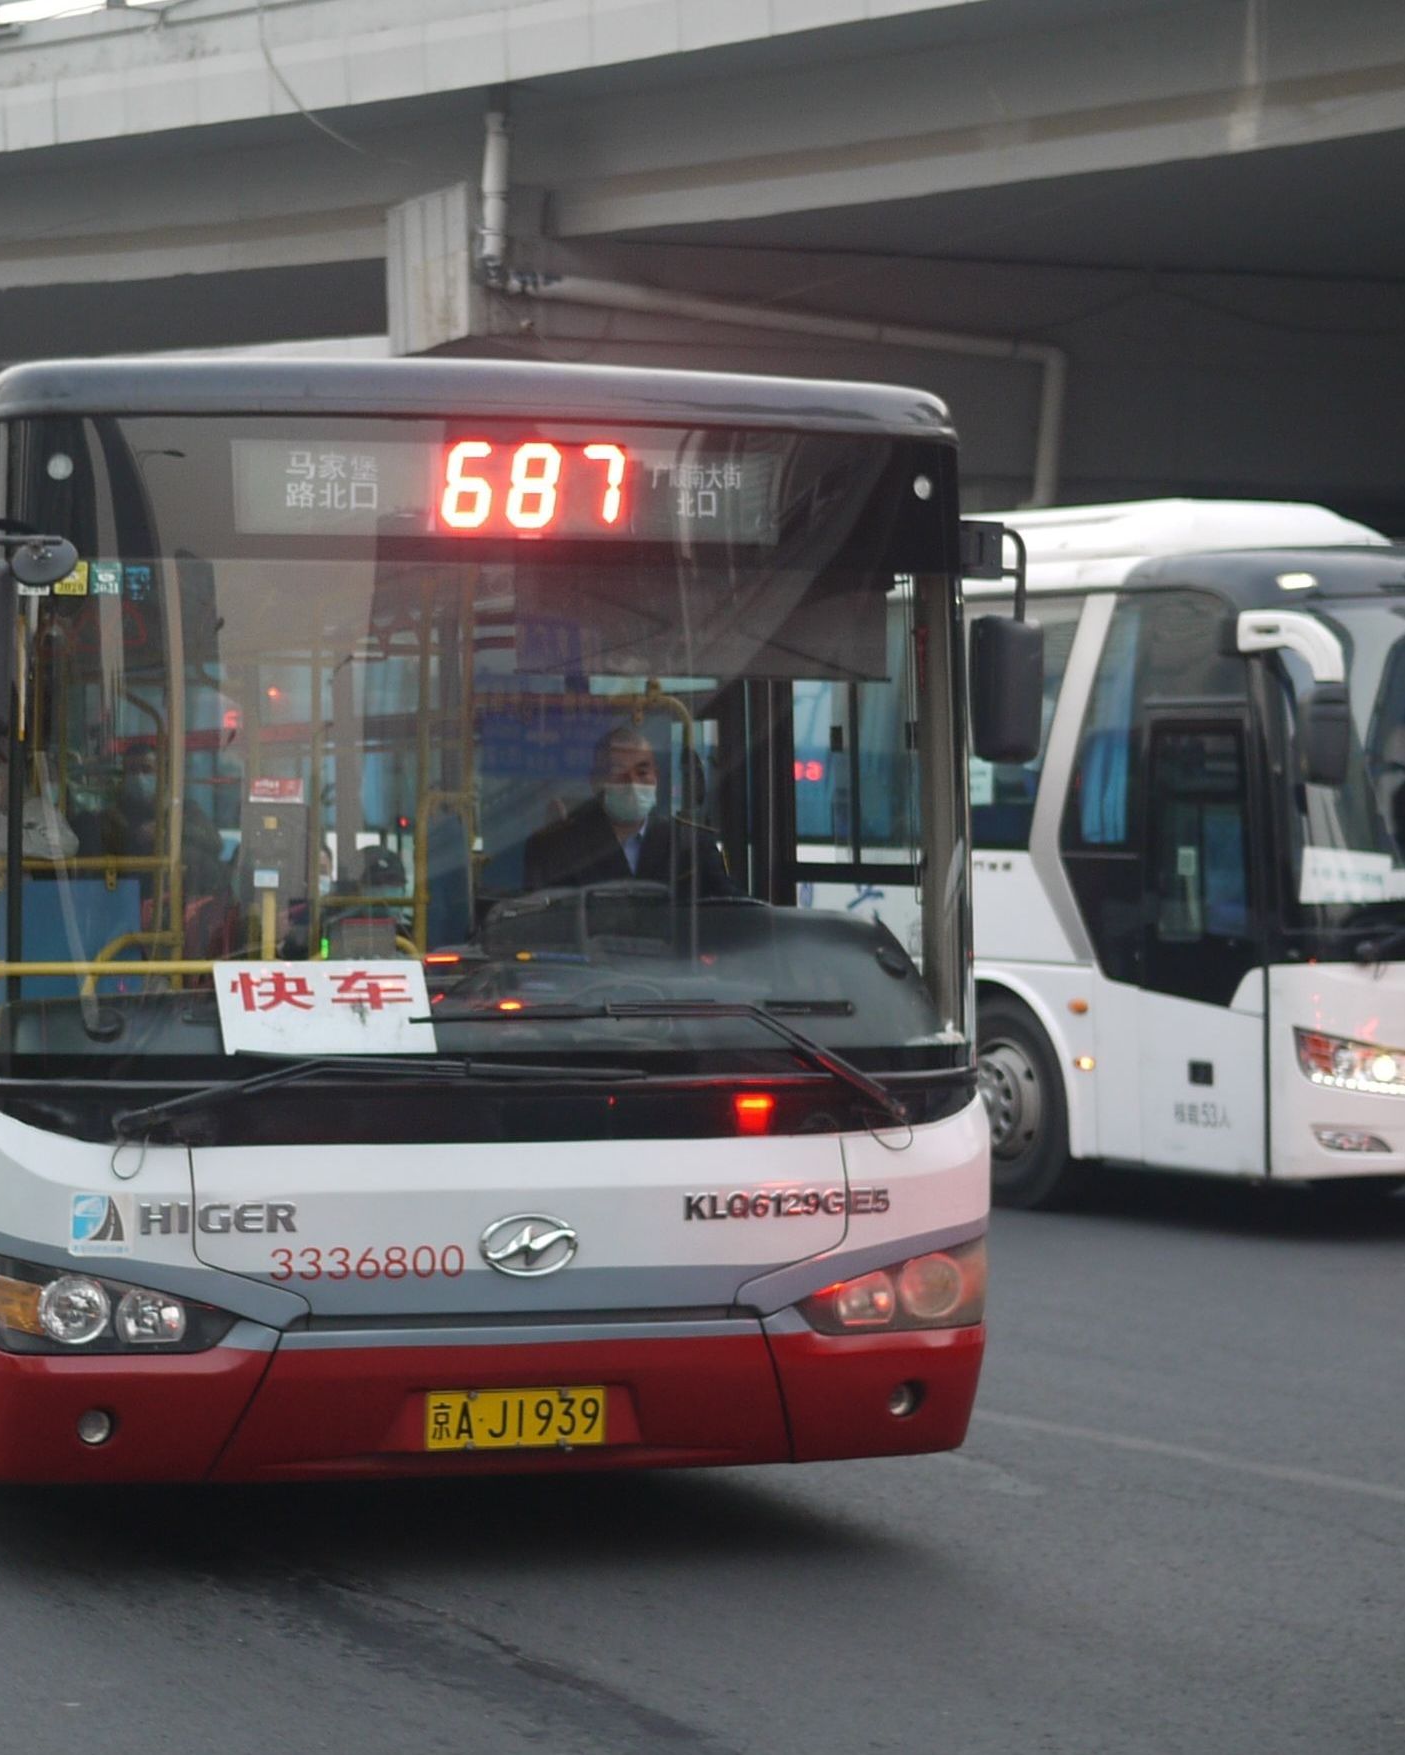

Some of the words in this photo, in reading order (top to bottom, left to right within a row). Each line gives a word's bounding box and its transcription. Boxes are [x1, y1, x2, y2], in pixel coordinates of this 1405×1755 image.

[285, 451, 378, 480] 马家堡
[285, 481, 378, 511] 路北口
[441, 441, 625, 528] 687
[677, 491, 717, 518] 北口
[230, 971, 413, 1012] 快车
[139, 1201, 299, 1235] HIGER
[270, 1244, 466, 1281] 3336800
